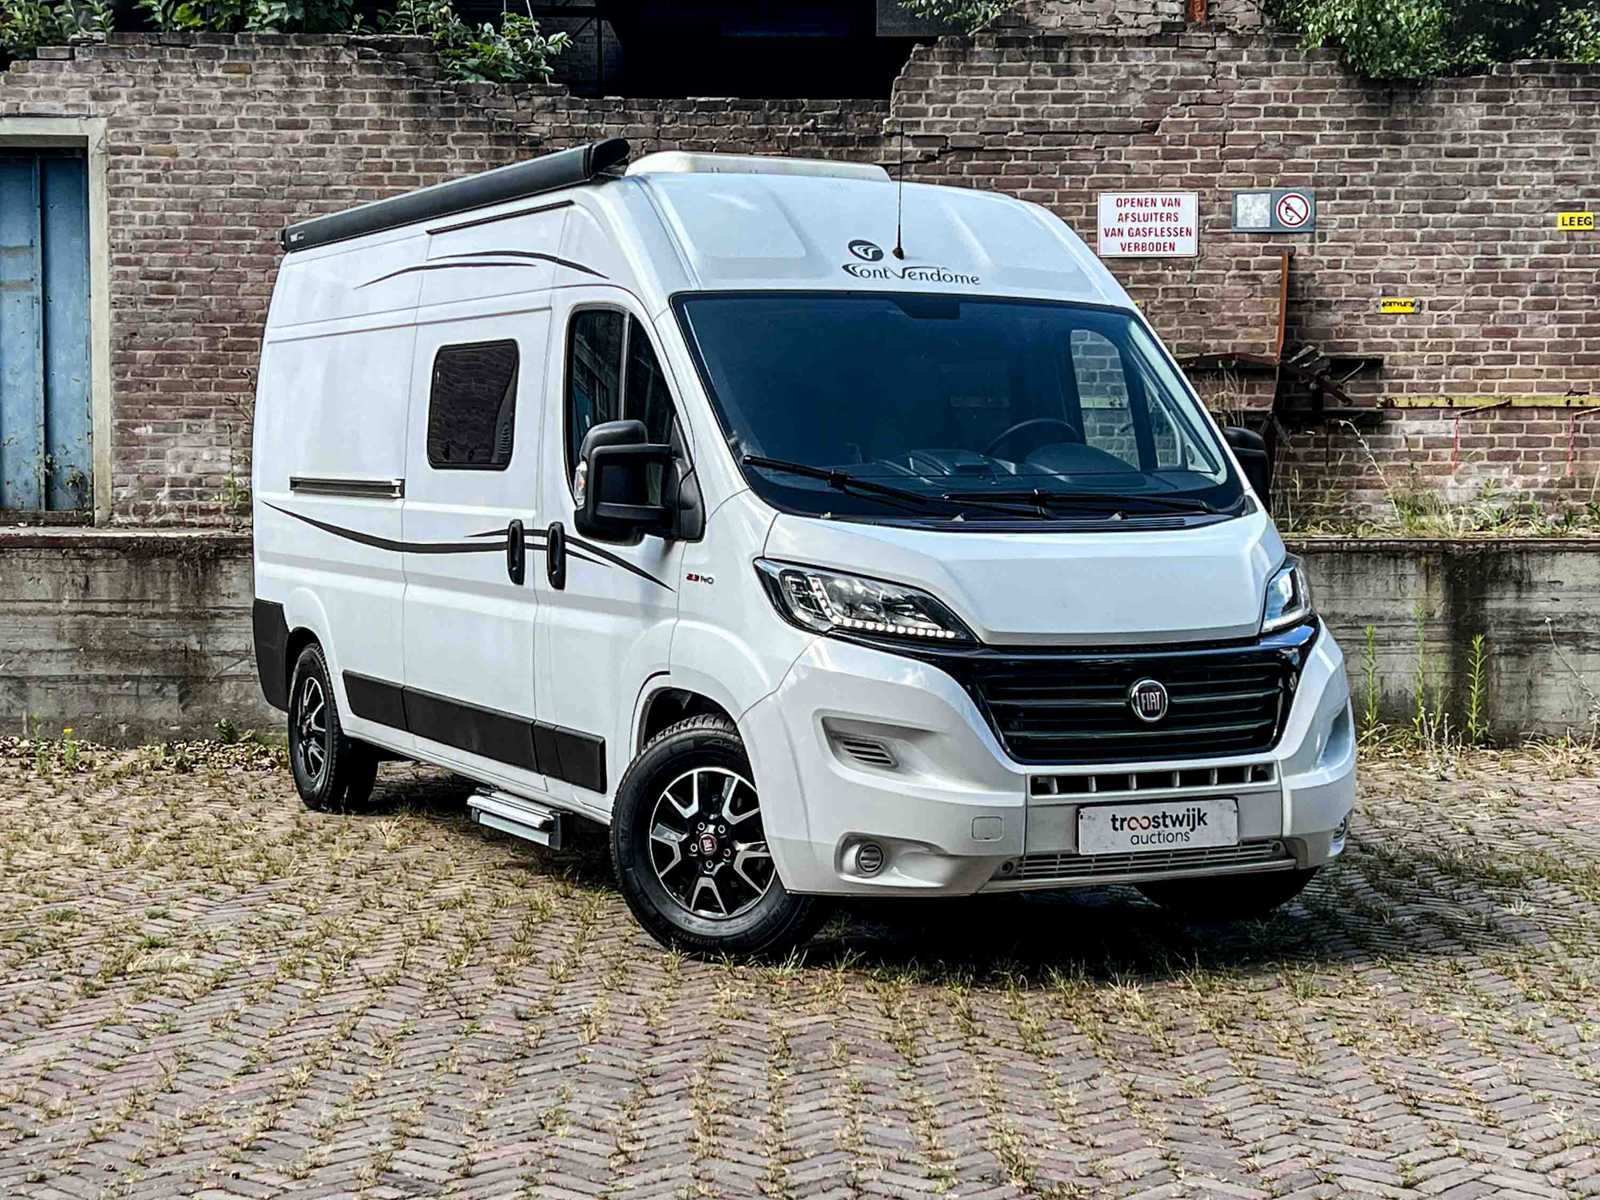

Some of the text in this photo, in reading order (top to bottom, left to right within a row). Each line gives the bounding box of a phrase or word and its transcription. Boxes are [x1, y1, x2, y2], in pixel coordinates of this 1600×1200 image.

[1116, 197, 1181, 208] OPENEN VAN
[1117, 212, 1179, 222] AFSLUITERS
[1561, 216, 1592, 226] LEEG
[1104, 227, 1192, 237] VAN GASFLESSEN
[1120, 242, 1176, 252] VERBODEN
[1141, 692, 1161, 711] FIAT
[1110, 808, 1208, 832] troostwijk
[1130, 830, 1190, 845] auctions
